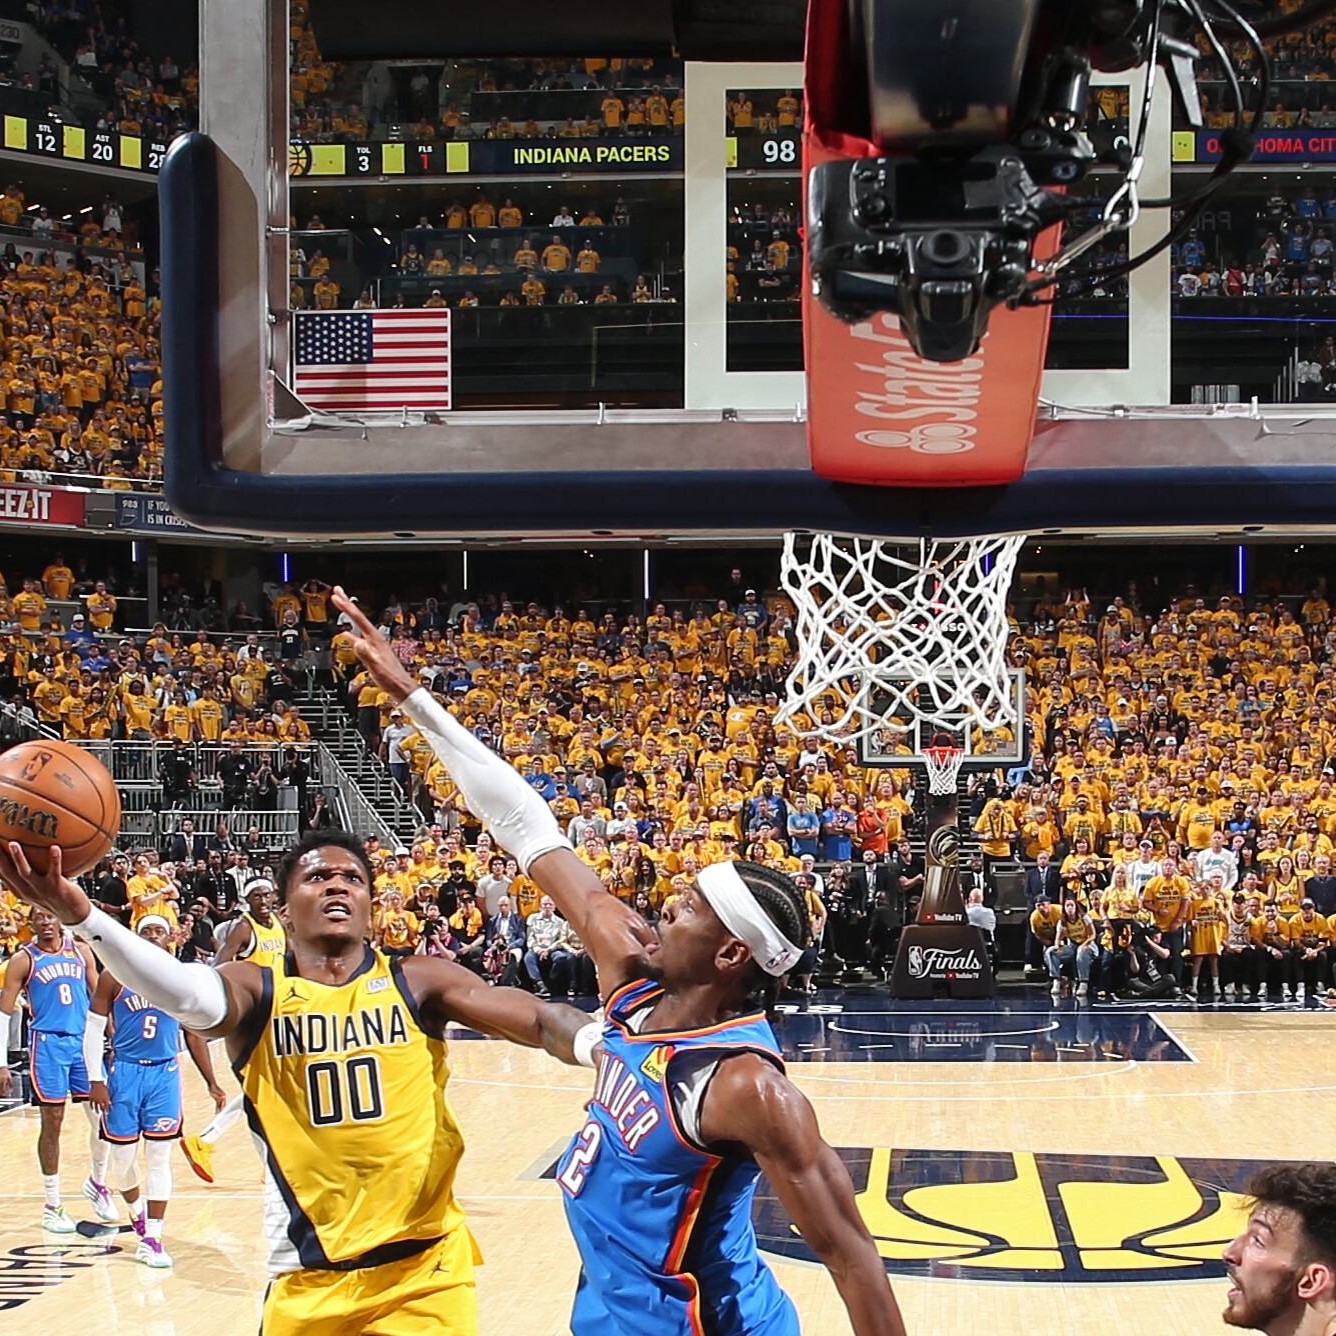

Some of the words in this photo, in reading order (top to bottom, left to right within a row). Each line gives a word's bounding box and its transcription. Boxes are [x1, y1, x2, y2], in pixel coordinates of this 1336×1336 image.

[38, 124, 52, 133] STL
[95, 134, 111, 143] AST
[35, 134, 56, 151] 12
[92, 144, 113, 161] 20
[763, 140, 796, 163] 98
[357, 155, 370, 172] 3
[421, 154, 430, 169] 1
[513, 147, 592, 165] INDIANA
[596, 145, 671, 163] PACERS
[35, 962, 83, 984] THUNDER
[915, 948, 982, 979] Finals
[58, 983, 73, 1005] 8
[142, 1015, 158, 1039] 5
[272, 1004, 408, 1058] INDIANA
[306, 1054, 385, 1127] 00
[557, 1121, 603, 1197] 2
